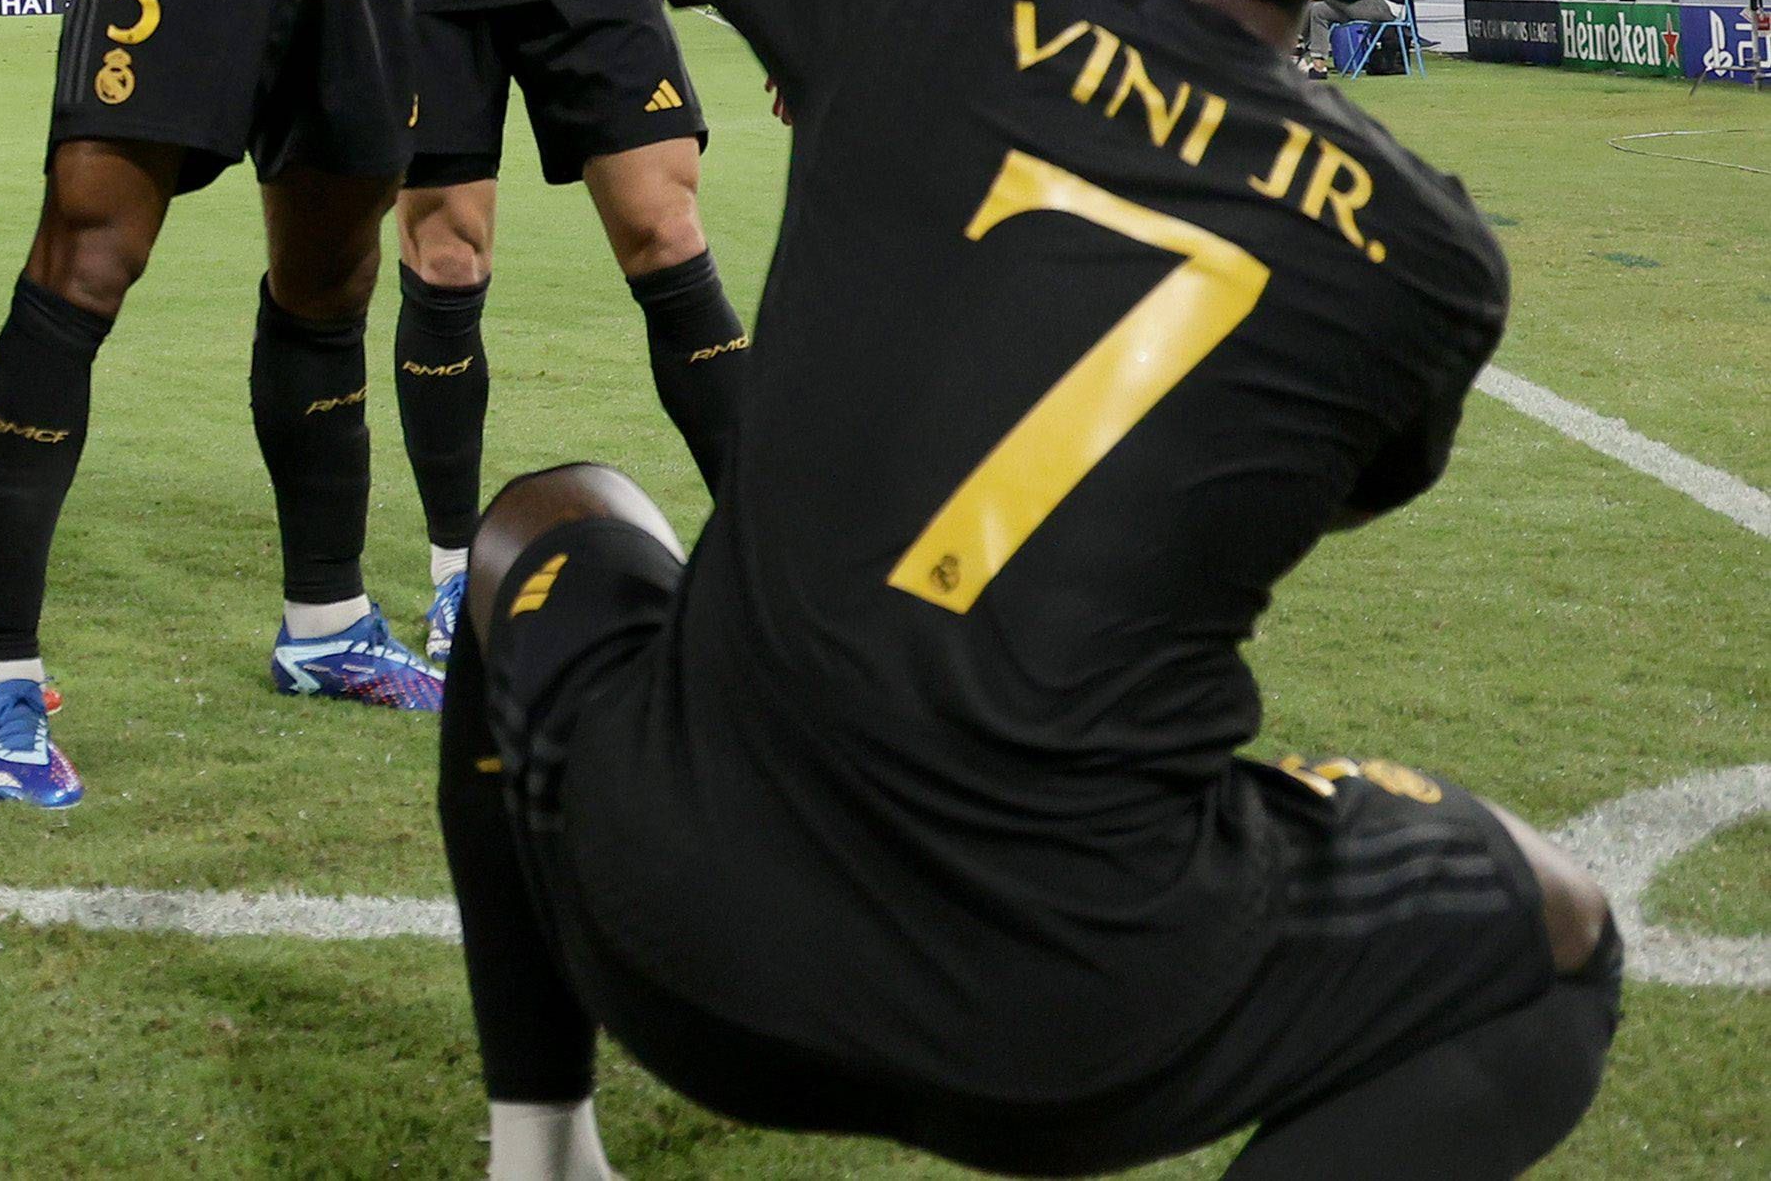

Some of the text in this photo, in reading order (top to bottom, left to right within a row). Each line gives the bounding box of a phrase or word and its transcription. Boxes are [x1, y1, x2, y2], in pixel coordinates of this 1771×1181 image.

[1013, 0, 1387, 264] VINI JR.
[1561, 9, 1661, 66] Heineken
[886, 148, 1272, 615] 7
